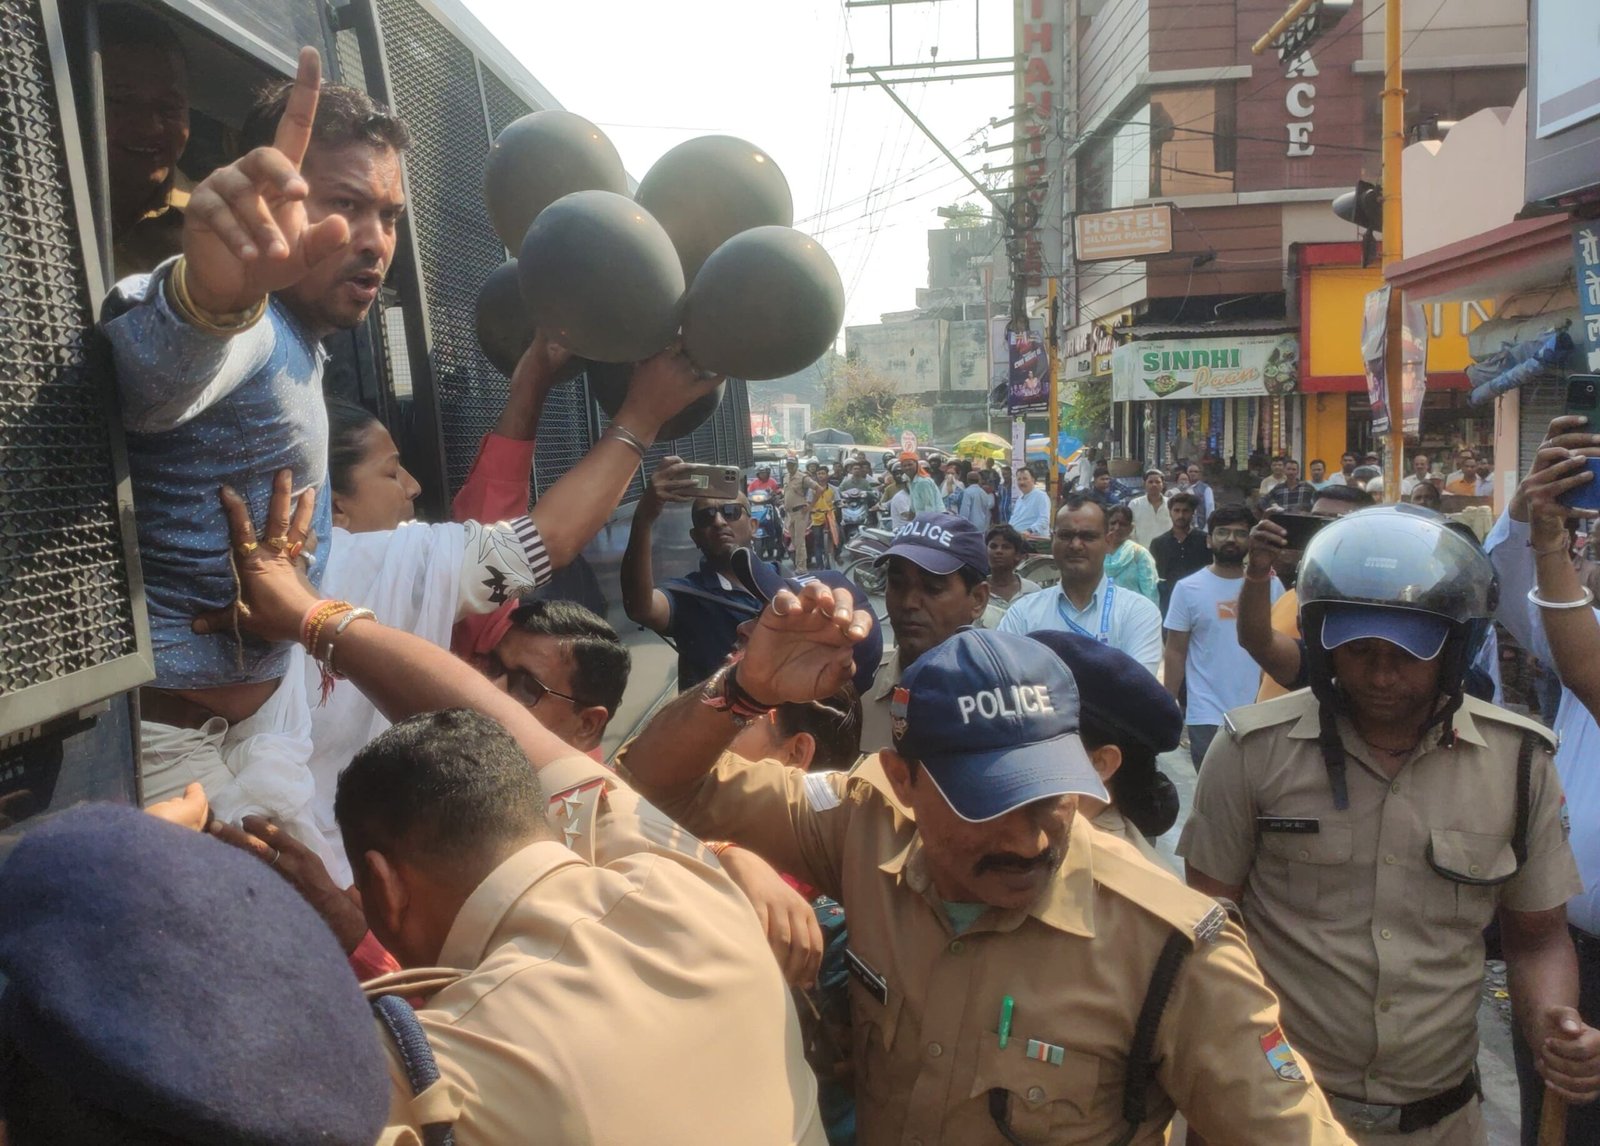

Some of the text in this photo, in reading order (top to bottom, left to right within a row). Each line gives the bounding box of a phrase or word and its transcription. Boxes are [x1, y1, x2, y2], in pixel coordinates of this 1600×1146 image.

[1084, 211, 1166, 234] HOTEL
[1123, 228, 1168, 240] PALACE
[1084, 231, 1121, 244] SILVER
[1143, 348, 1240, 372] SINDHI
[1193, 365, 1259, 394] Paan
[895, 521, 955, 548] POLICE
[957, 683, 1055, 725] POLICE
